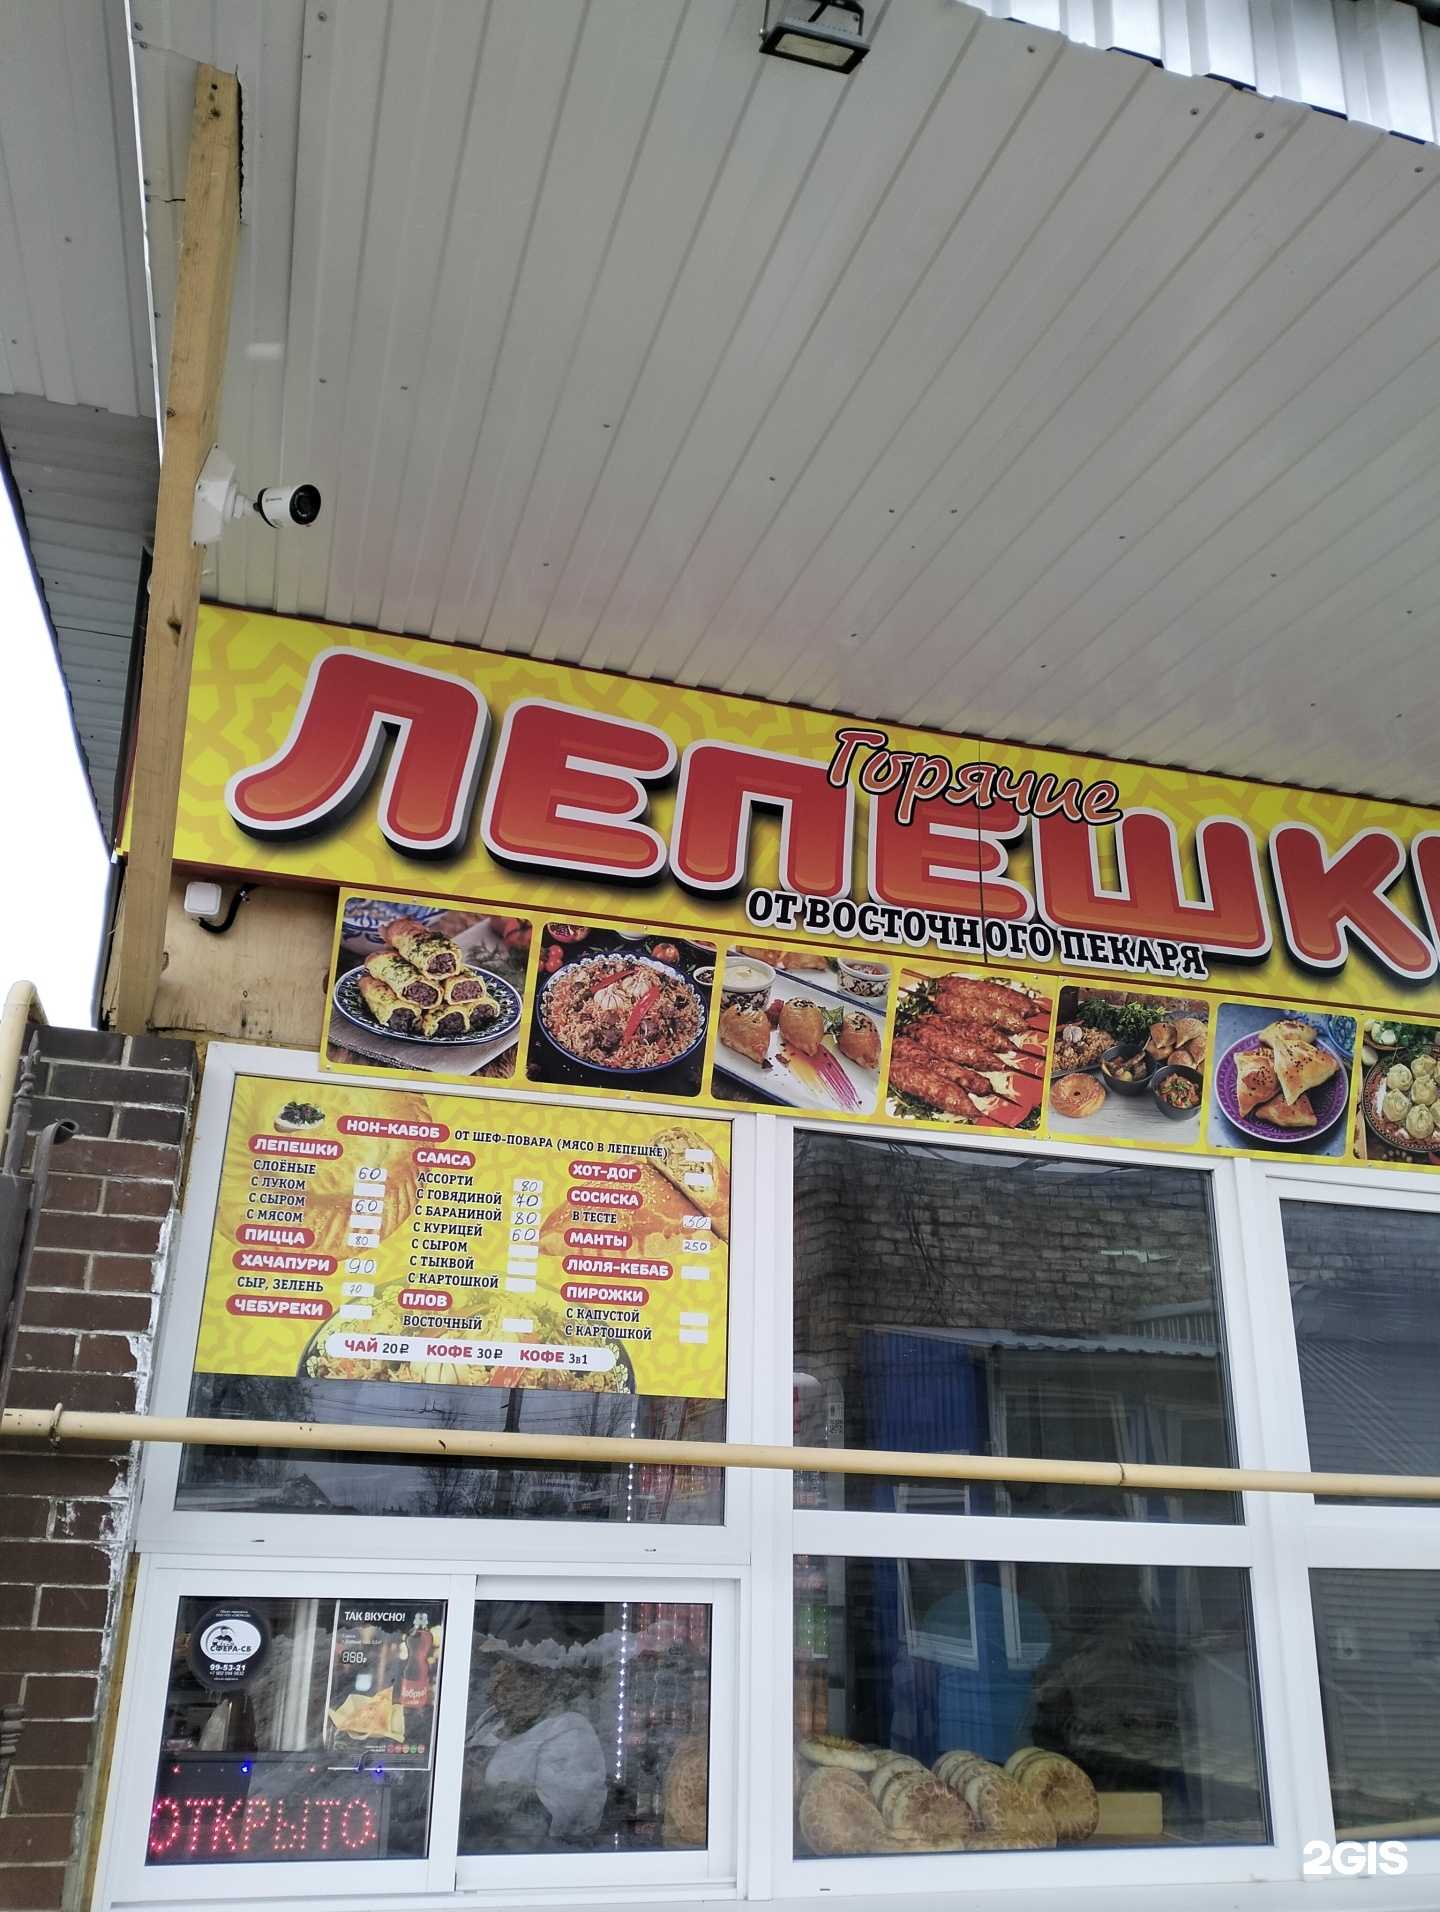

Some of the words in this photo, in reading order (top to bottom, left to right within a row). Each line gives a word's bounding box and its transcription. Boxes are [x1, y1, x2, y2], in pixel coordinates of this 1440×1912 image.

[828, 727, 1125, 826] Горячие
[224, 645, 1440, 980] ЛЕПЕШК
[747, 889, 799, 926] ОТ
[805, 896, 1052, 958] ВОСТОЧНОГО
[1060, 930, 1208, 976] ПЕКАРЯ
[346, 1119, 441, 1139] НОН-КАБОБ
[253, 1138, 339, 1157] ЛЕПЕШКИ
[454, 1130, 470, 1140] ОТ
[473, 1131, 553, 1148] ШЕФ-ПОВАРА
[556, 1138, 594, 1152] (МЯСО
[597, 1142, 604, 1152] В
[607, 1143, 669, 1160] ЛЕПЕШКЕ)
[253, 1158, 316, 1175] СЛОЁНЫЕ
[416, 1151, 472, 1167] САМСА
[358, 1167, 382, 1180] 60
[417, 1172, 474, 1187] АССОРТИ
[572, 1163, 637, 1180] ХОТ-ДОГ
[251, 1176, 258, 1186] С
[261, 1177, 306, 1190] ЛУКОМ
[520, 1180, 538, 1192] 80
[248, 1192, 256, 1203] С
[260, 1193, 306, 1207] СЫРОМ
[416, 1188, 424, 1199] С
[427, 1189, 503, 1205] ГОВЯДИНОЙ
[571, 1189, 640, 1206] СОСИСКА
[354, 1200, 378, 1213] 60
[415, 1205, 422, 1216] С
[425, 1206, 503, 1221] БАРАНИНОЙ
[246, 1208, 253, 1219] С
[257, 1209, 304, 1223] МЯСОМ
[514, 1211, 538, 1225] 80
[572, 1211, 580, 1221] В
[583, 1212, 618, 1224] ТЕСТЕ
[244, 1227, 306, 1245] ПИЦЦА
[413, 1221, 421, 1232] С
[424, 1222, 484, 1237] КУРИЦЕЙ
[511, 1228, 537, 1242] 60
[411, 1238, 419, 1249] С
[422, 1239, 468, 1252] СЫРОМ
[569, 1230, 628, 1247] МАНТЫ
[684, 1241, 708, 1251] 250
[240, 1253, 330, 1272] ХАЧАПУРИ
[409, 1255, 417, 1266] С
[420, 1256, 474, 1270] ТЫКВОЙ
[566, 1258, 669, 1277] ЛЮЛЯ-КЕБАБ
[237, 1276, 269, 1291] СЫР,
[272, 1278, 324, 1292] ЗЕЛЕНЬ
[408, 1272, 415, 1283] С
[418, 1273, 499, 1288] КАРТОШКОЙ
[402, 1292, 447, 1307] ПЛОВ
[566, 1286, 643, 1303] ПИРОЖКИ
[234, 1298, 323, 1316] ЧЕБУРЕКИ
[566, 1308, 573, 1318] С
[576, 1308, 640, 1322] КАПУСТОЙ
[403, 1315, 482, 1330] ВОСТОЧНЫЙ
[565, 1325, 572, 1335] С
[576, 1326, 652, 1340] КАРТОШКОЙ
[344, 1337, 378, 1353] ЧАЙ
[427, 1344, 473, 1358] КОФЕ
[520, 1350, 564, 1363] КОФЕ
[344, 1611, 362, 1621] ТАК
[364, 1612, 406, 1622] ВКУСНО!
[150, 1798, 374, 1852] ОТКРЫТО
